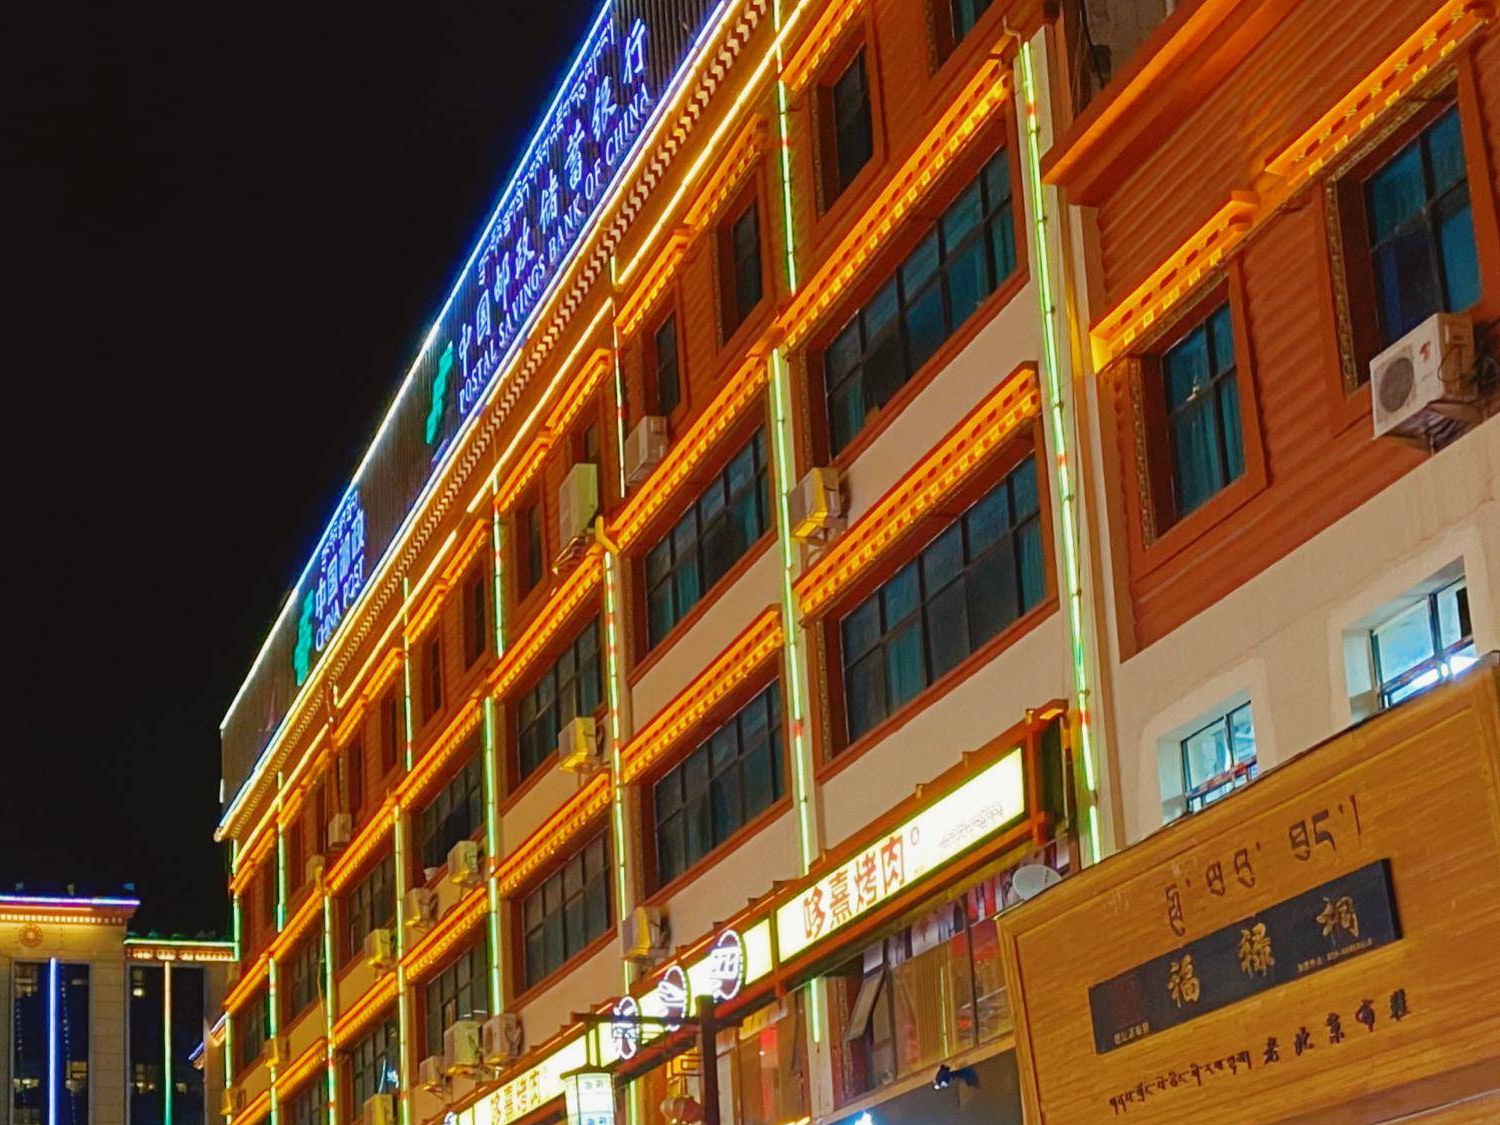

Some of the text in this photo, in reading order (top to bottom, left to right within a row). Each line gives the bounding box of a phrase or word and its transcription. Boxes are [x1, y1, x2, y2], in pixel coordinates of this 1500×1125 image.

[459, 18, 645, 377] 中国邮政储蓄银行
[459, 82, 651, 414] POSTAL SAVINGS BANK OF CHINA
[343, 554, 365, 609] POST
[1263, 988, 1412, 1064] 老北京布鞋
